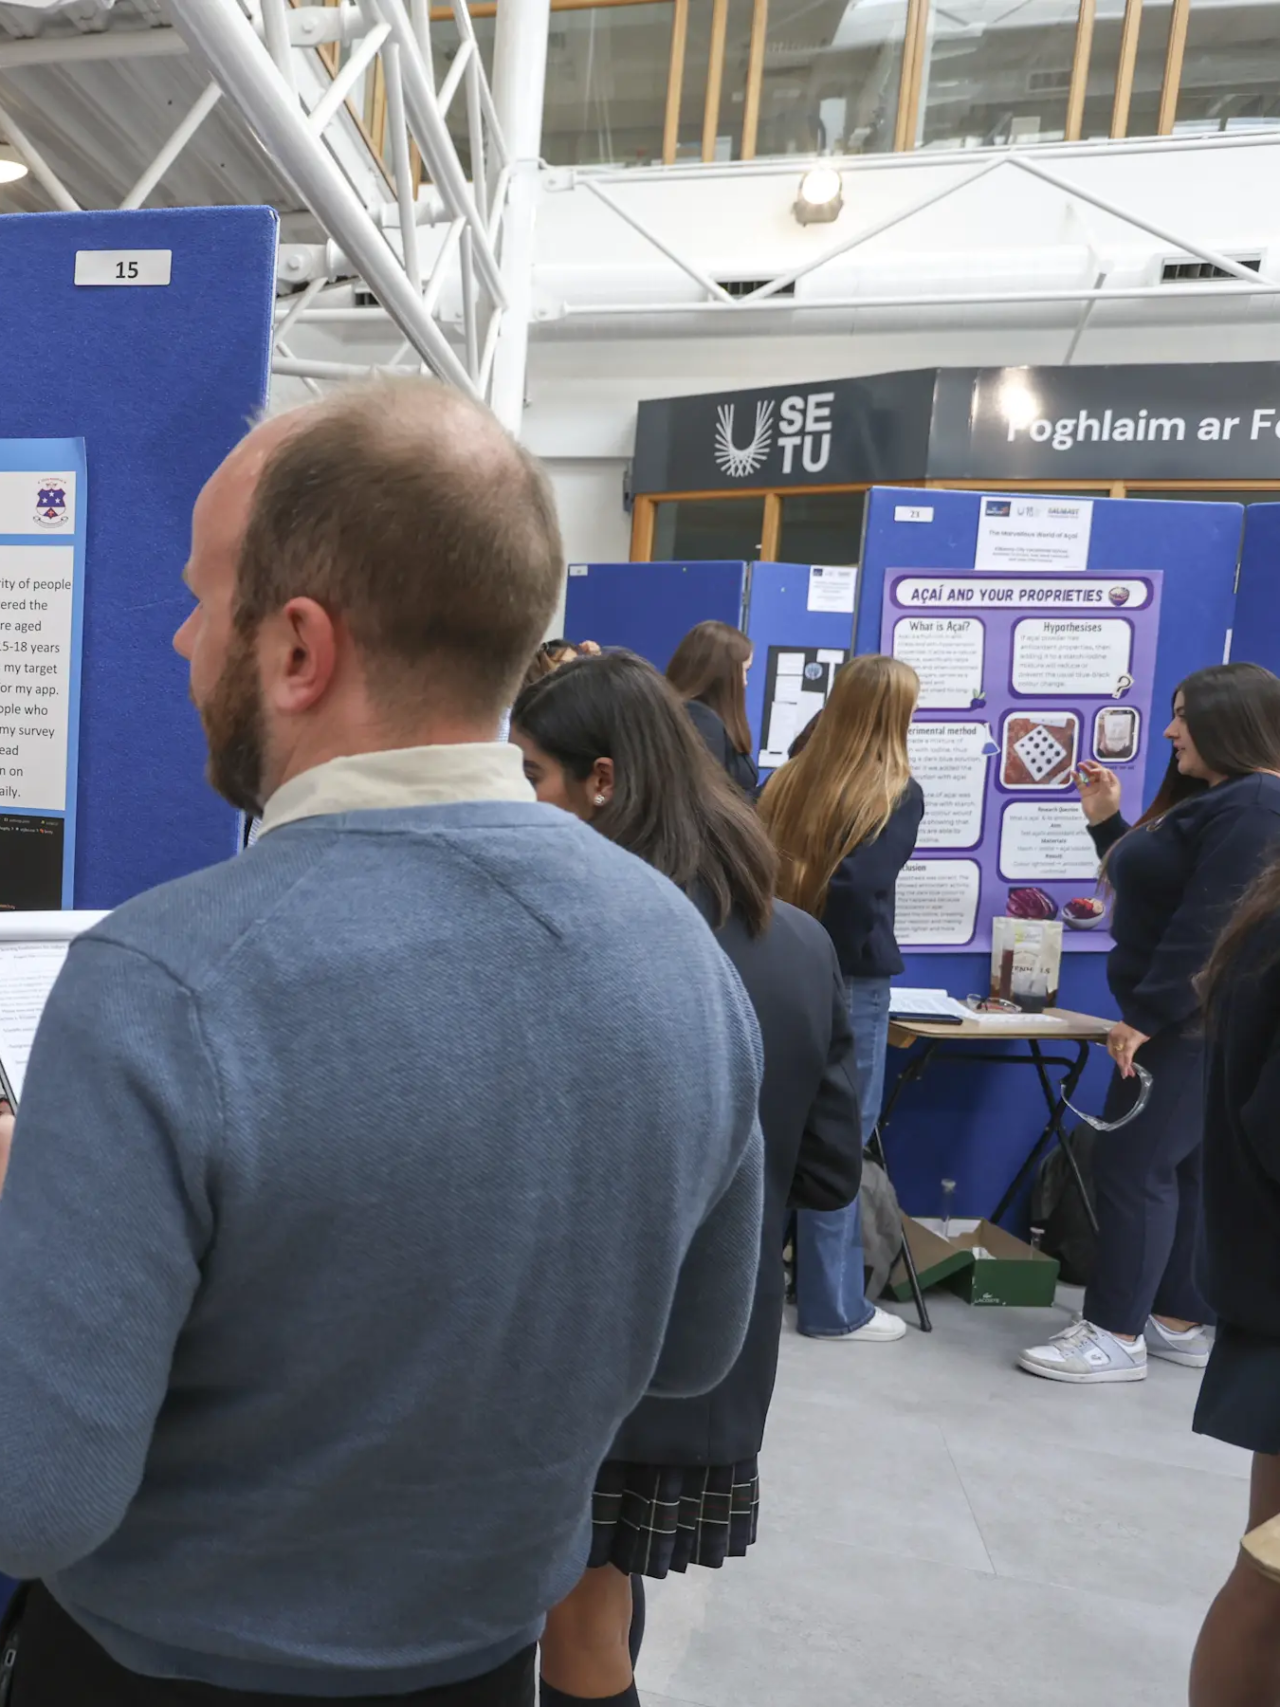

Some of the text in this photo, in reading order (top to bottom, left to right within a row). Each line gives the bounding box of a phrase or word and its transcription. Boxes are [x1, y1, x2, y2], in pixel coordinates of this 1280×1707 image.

[116, 262, 139, 279] 15
[779, 392, 835, 435] SE
[1197, 416, 1240, 441] ar
[1250, 408, 1280, 441] F
[777, 433, 831, 474] TU
[910, 510, 920, 518] 23
[18, 577, 30, 589] of
[33, 578, 71, 592] people
[910, 584, 1103, 603] AÇAÍ AND YOUR PROPRIETIES
[29, 599, 48, 610] the
[14, 620, 42, 634] aged
[909, 621, 933, 631] What
[936, 623, 944, 631] is
[1043, 621, 1102, 633] Hypothesises
[908, 726, 977, 735] erimental method
